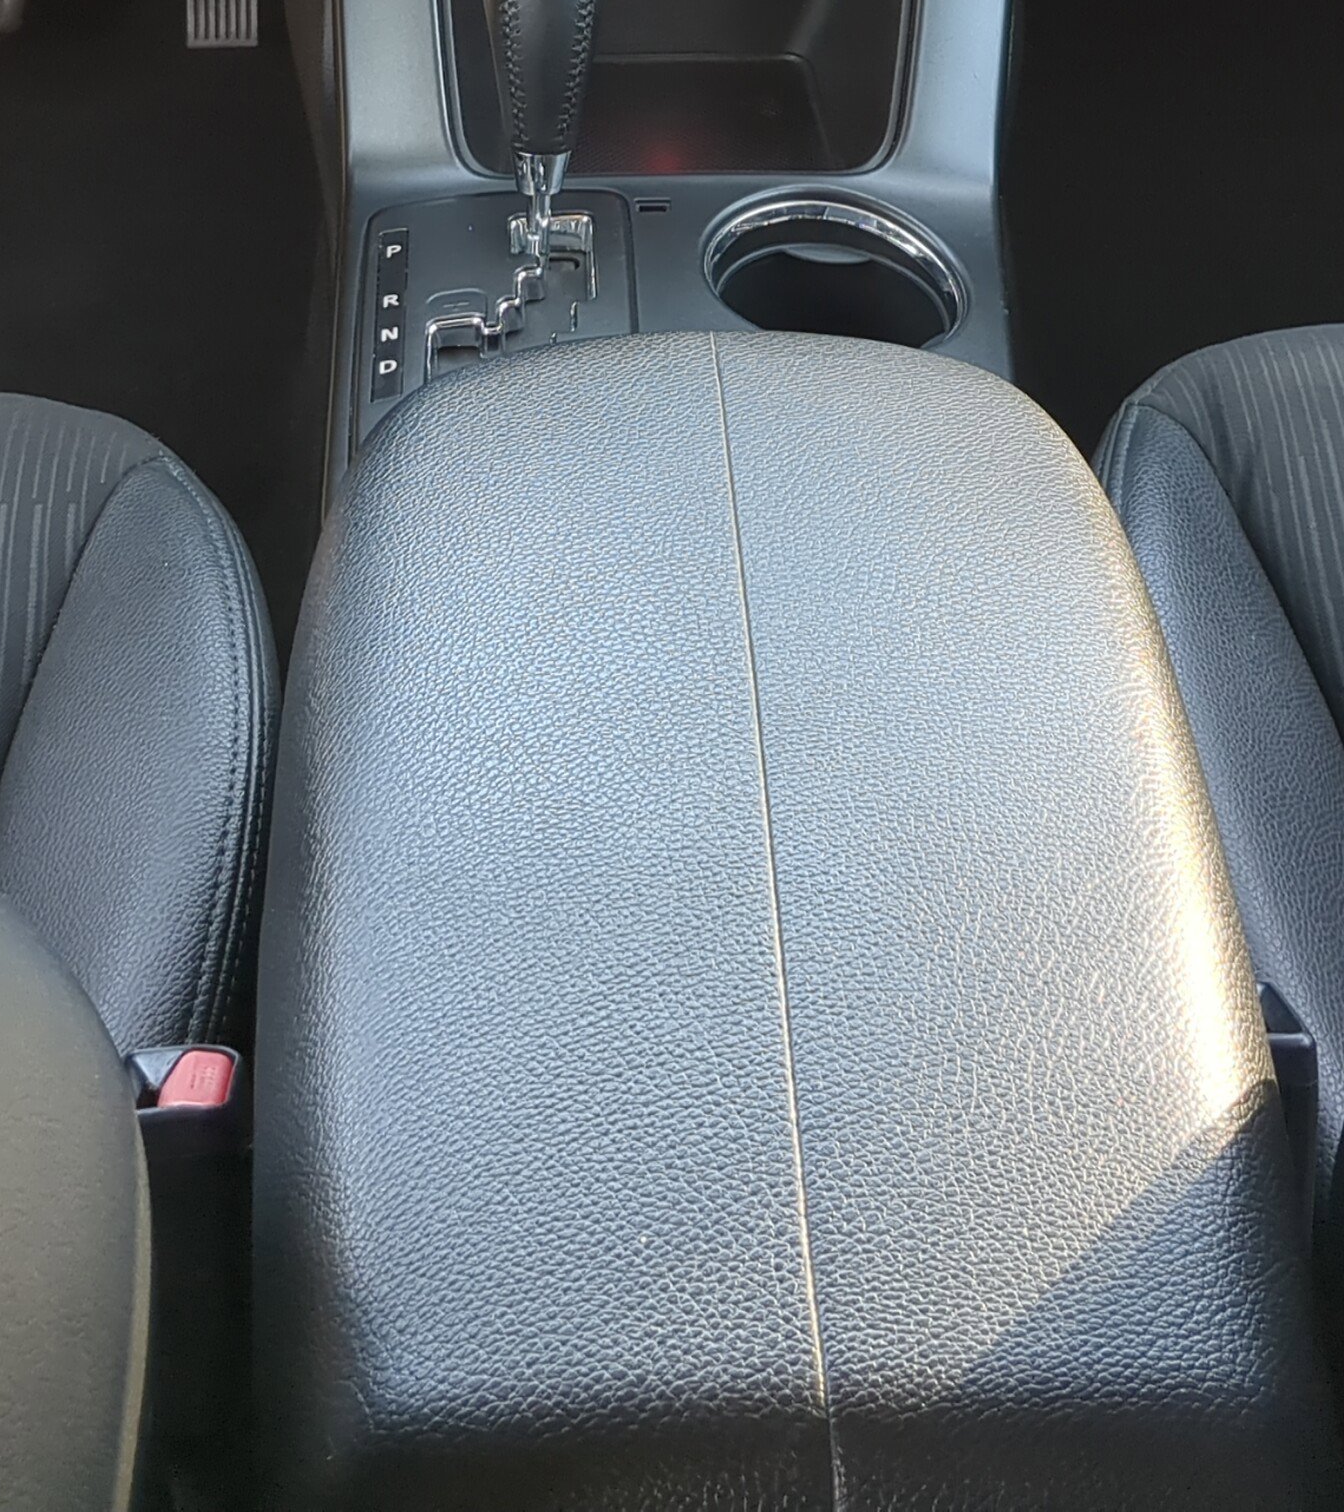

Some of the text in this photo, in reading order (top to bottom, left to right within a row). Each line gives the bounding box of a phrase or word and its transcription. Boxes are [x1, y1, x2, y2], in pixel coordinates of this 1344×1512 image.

[386, 245, 402, 258] P
[383, 293, 400, 308] R
[380, 326, 399, 342] N
[379, 359, 397, 375] D
